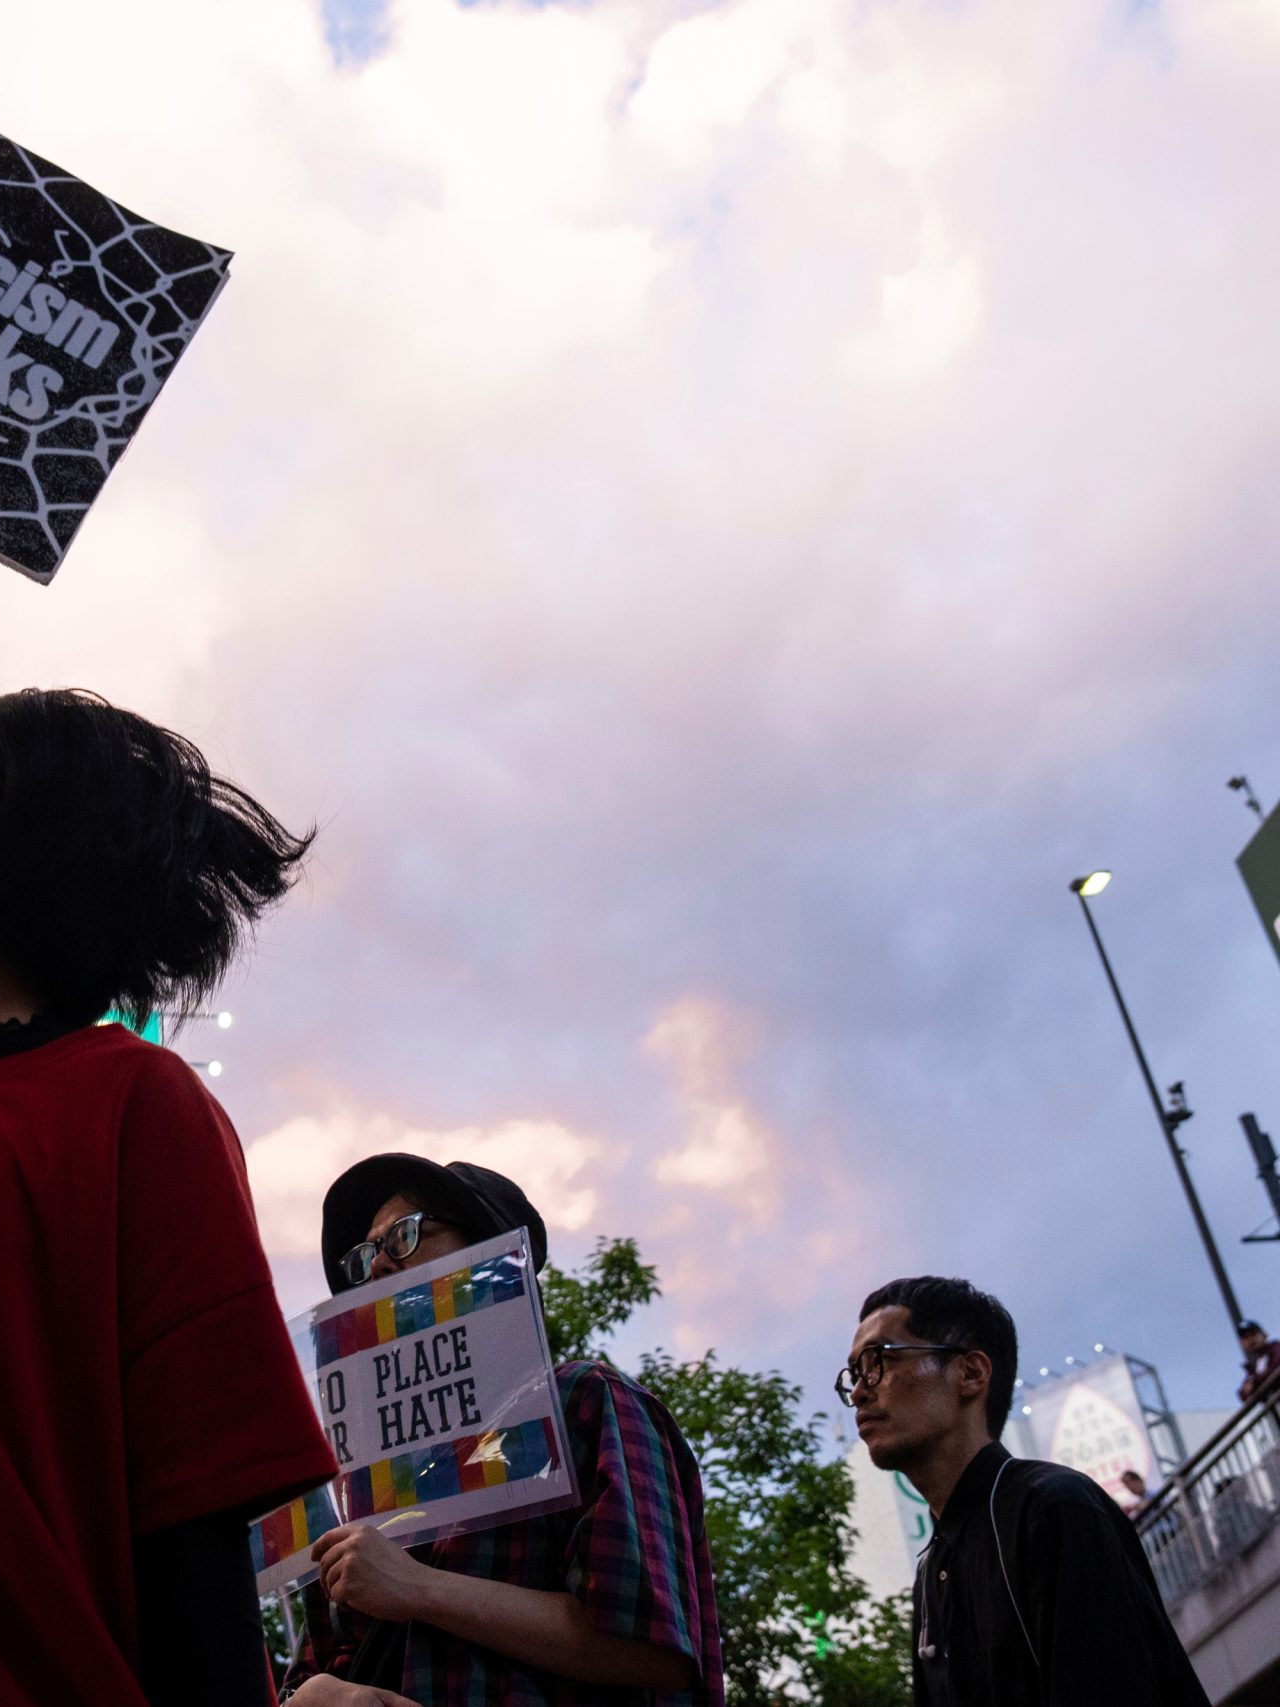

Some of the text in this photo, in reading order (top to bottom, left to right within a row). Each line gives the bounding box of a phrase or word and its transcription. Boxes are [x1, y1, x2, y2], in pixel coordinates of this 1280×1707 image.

[317, 1325, 472, 1416] O PLACE
[377, 1377, 482, 1451] HATE
